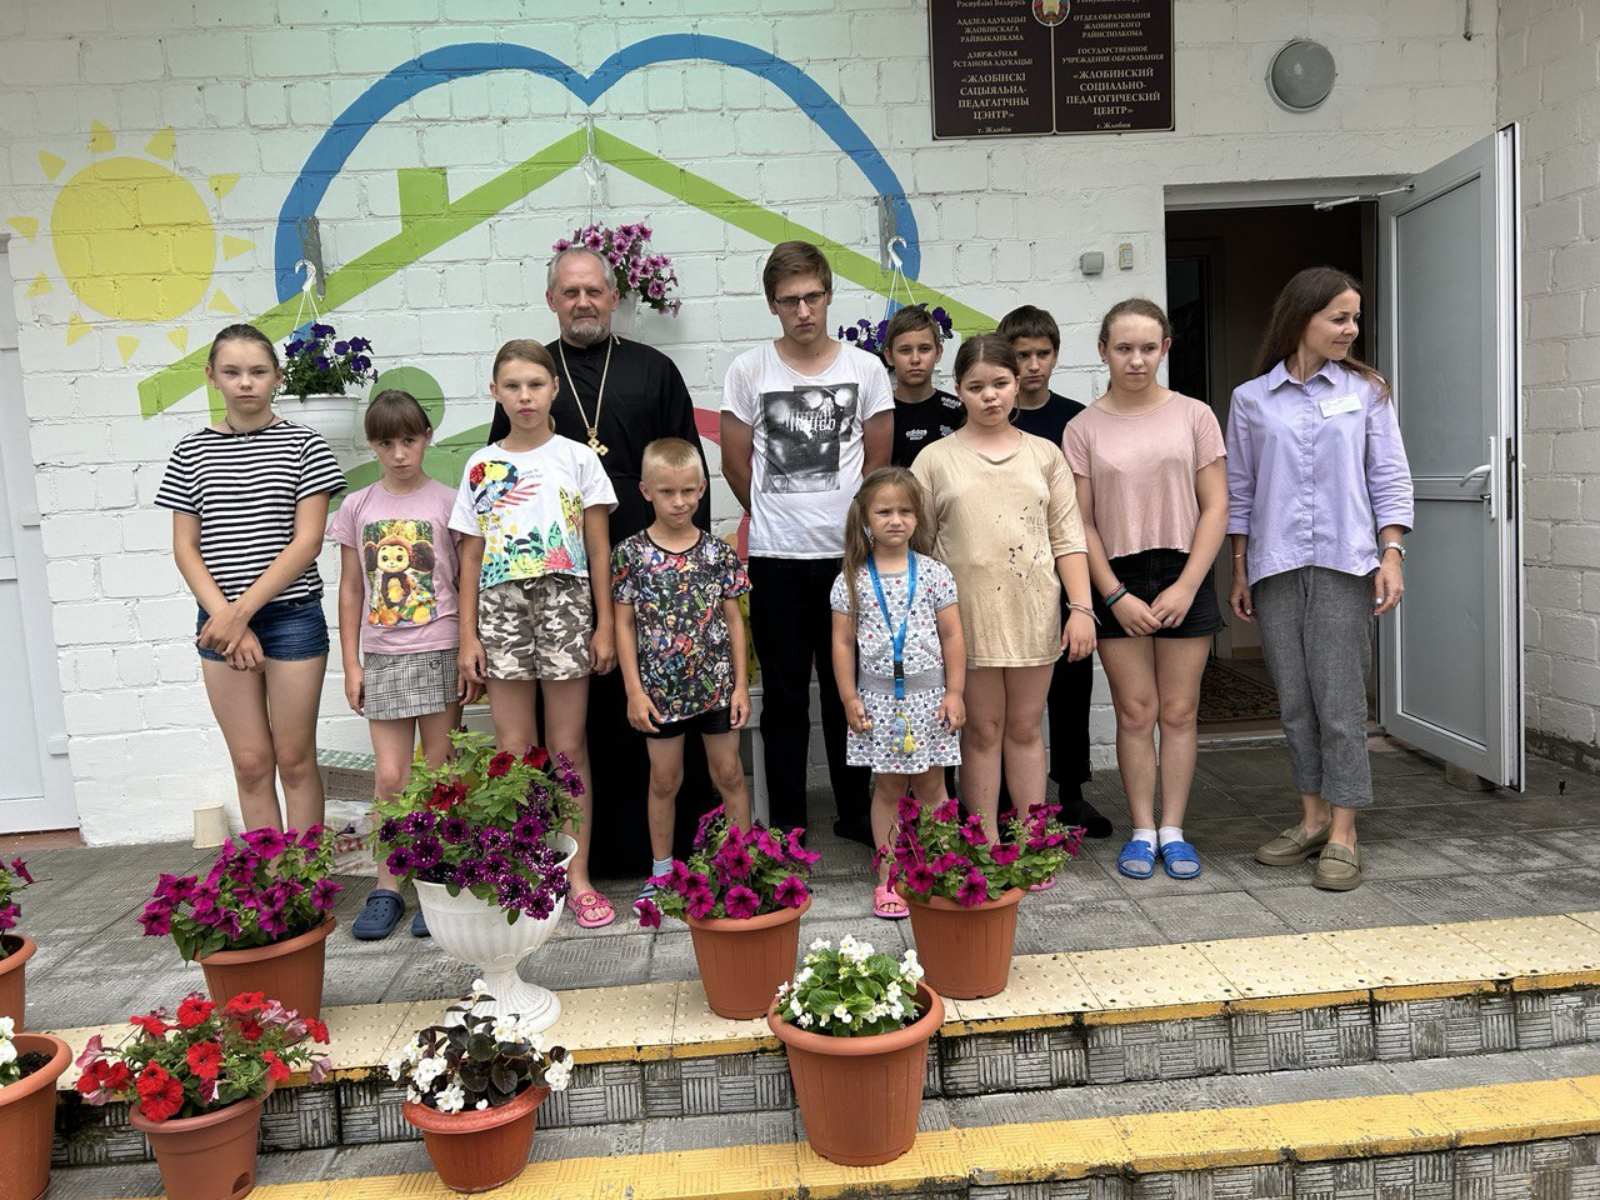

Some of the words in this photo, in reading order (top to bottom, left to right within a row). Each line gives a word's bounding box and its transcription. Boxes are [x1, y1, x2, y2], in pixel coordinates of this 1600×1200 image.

[1098, 12, 1151, 20] ОБРАЗОВАНИЯ
[1083, 21, 1141, 30] ЖЛОБИНСКОГО
[1077, 46, 1149, 55] ГОСУДАРСТВЕННОЕ
[1111, 53, 1164, 62] ОБРАЗОВАНИЯ
[961, 72, 1026, 83] «ЖЛОБІНСКІ
[1072, 66, 1155, 80] «ЖЛОБИНСКИЙ
[959, 85, 1028, 96] САЦЫЯЛЬНА-
[1079, 80, 1147, 92] СОЦИАЛЬНО-
[1065, 90, 1161, 105] ПЕДАГОГИЧЕСКИЙ
[958, 97, 1030, 109] ПЕДАГАГІЧНЫ
[973, 110, 1015, 120] ЦЭНТР»
[1093, 106, 1134, 116] ЦЕНТР»
